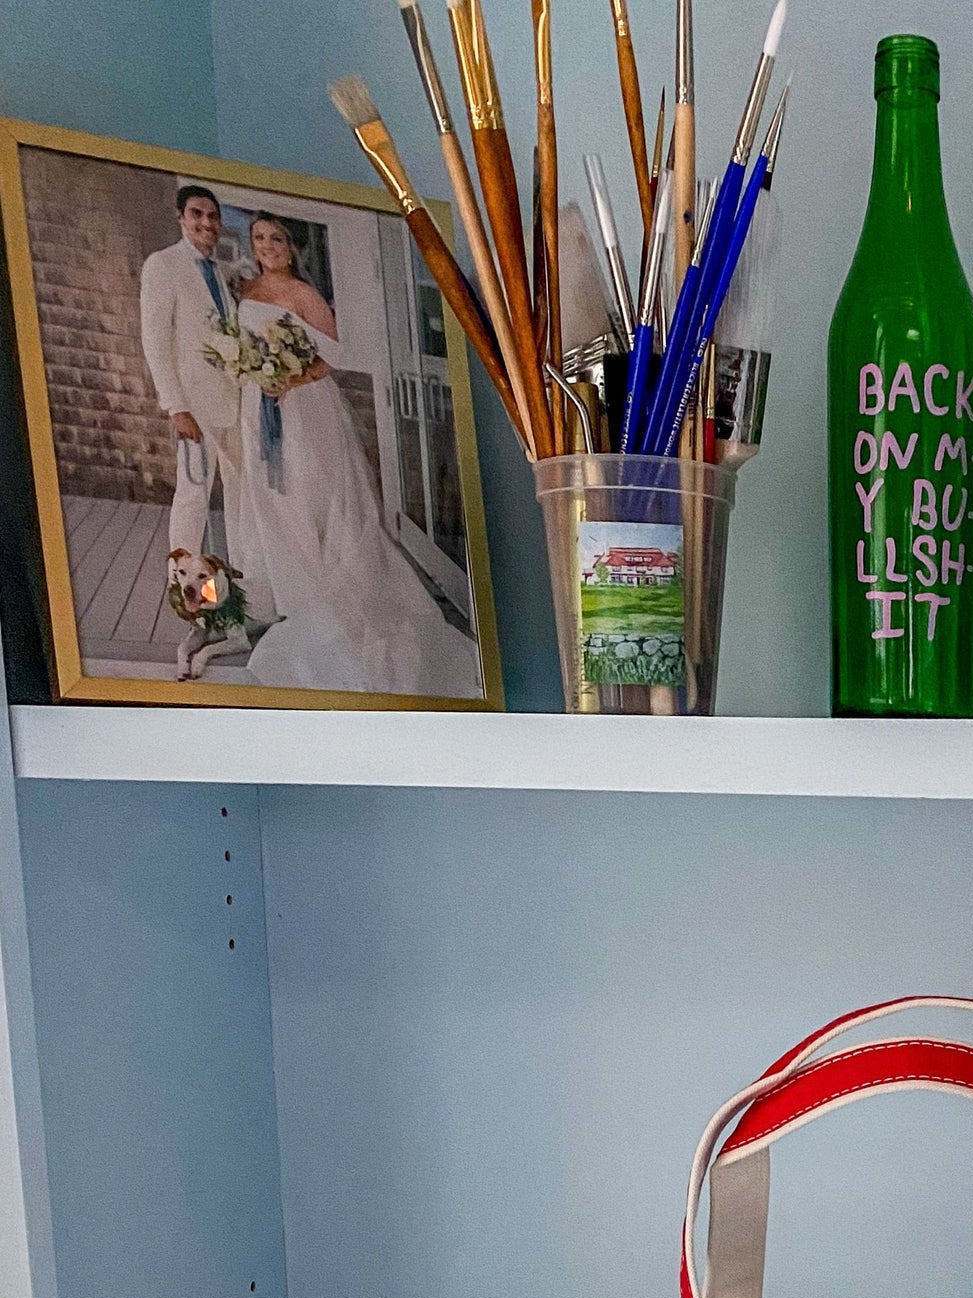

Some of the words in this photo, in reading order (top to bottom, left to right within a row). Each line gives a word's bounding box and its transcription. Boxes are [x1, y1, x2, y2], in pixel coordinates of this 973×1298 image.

[854, 431, 918, 474] ON
[855, 478, 884, 532] Y
[866, 592, 950, 641] IT
